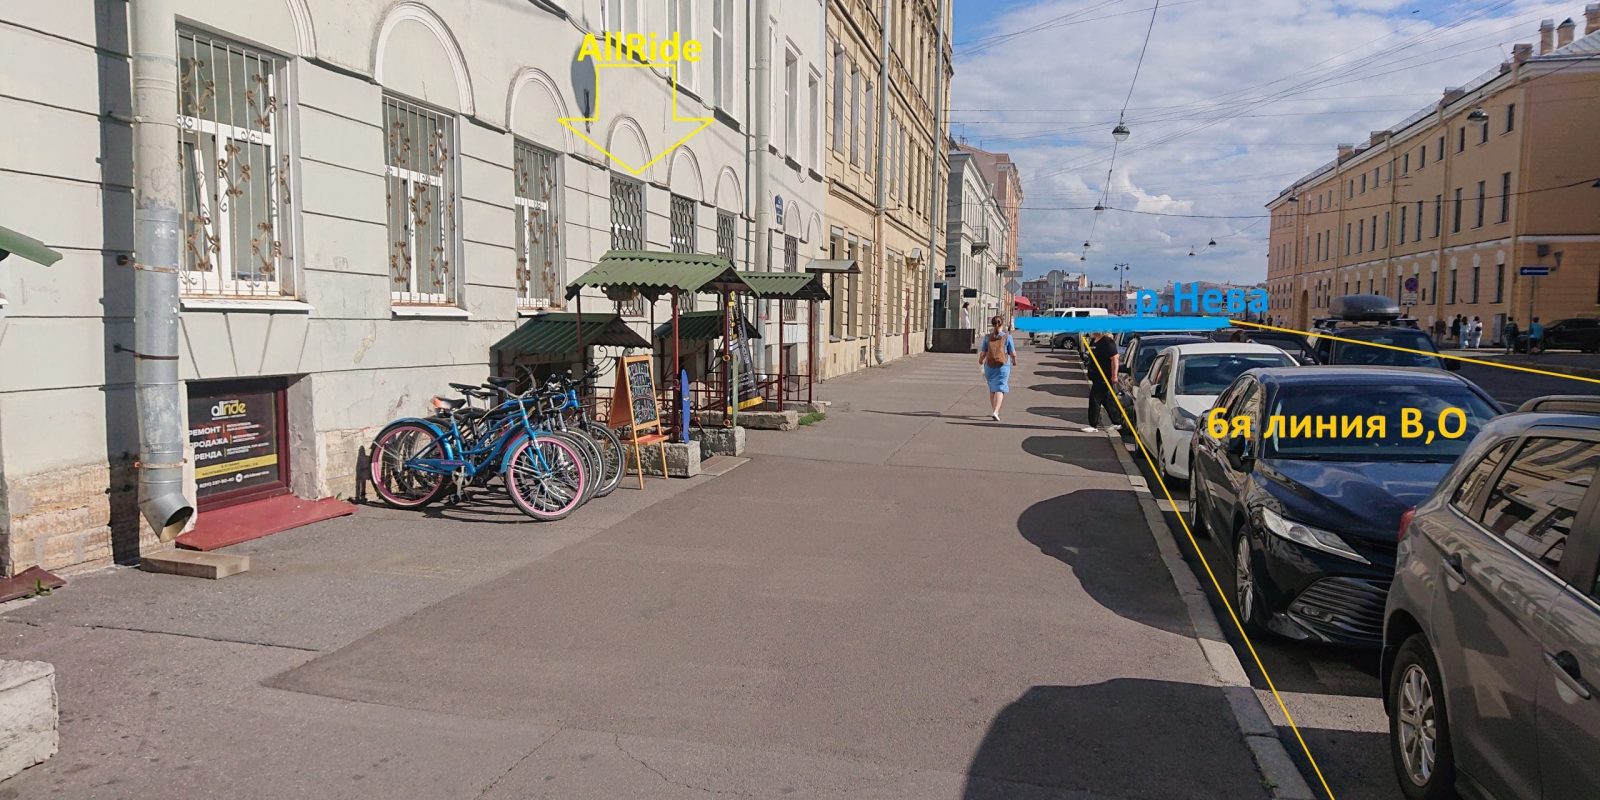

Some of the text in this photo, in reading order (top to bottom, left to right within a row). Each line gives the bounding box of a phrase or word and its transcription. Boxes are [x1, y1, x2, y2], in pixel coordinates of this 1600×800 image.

[211, 400, 246, 417] allride
[188, 426, 221, 437] РЕМОНТ
[194, 450, 222, 461] РЕНДА
